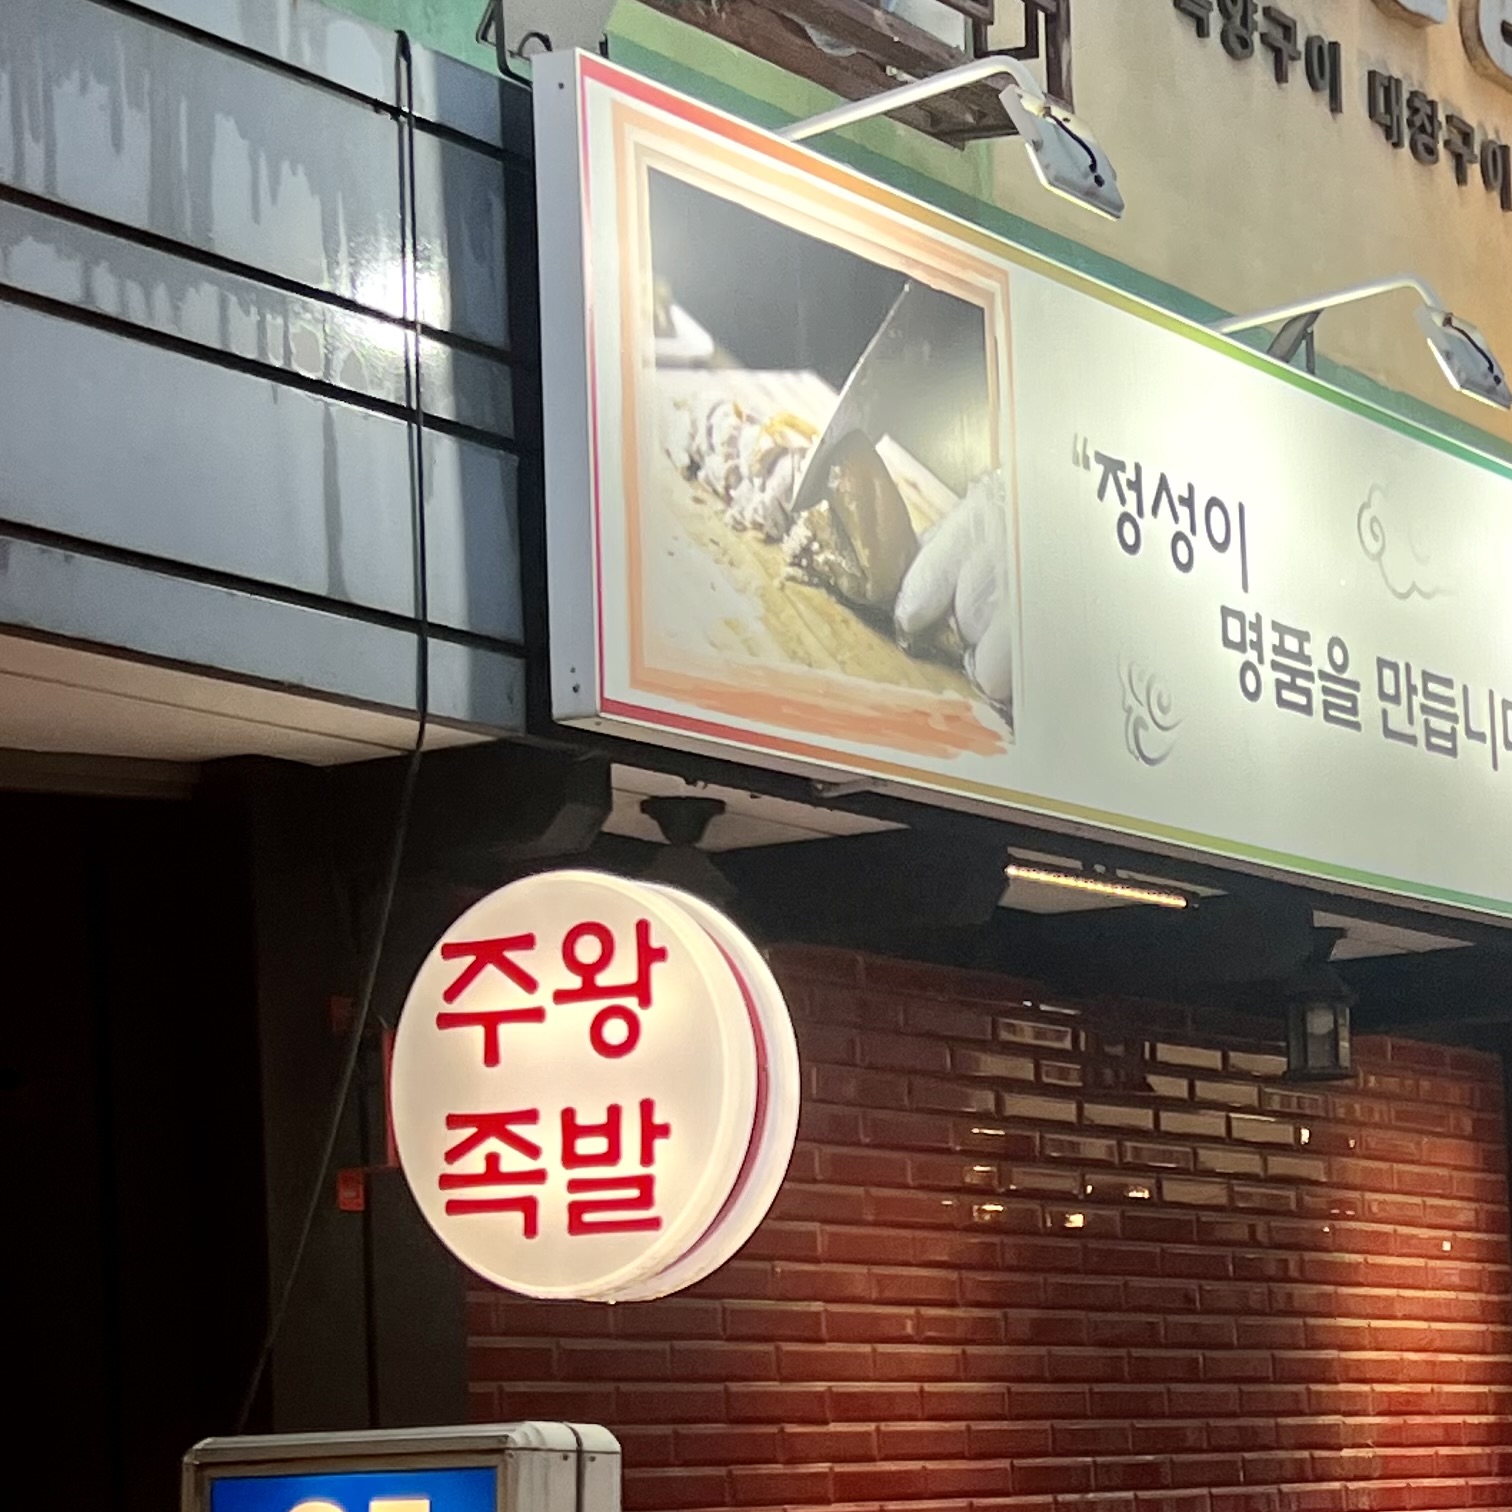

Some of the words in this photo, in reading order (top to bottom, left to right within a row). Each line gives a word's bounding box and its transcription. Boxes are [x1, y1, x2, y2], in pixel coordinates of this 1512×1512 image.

[1367, 70, 1512, 212] 대창구이
[1219, 604, 1363, 733] 명품을
[435, 917, 669, 1069] 주왕
[438, 1096, 672, 1240] 족발
